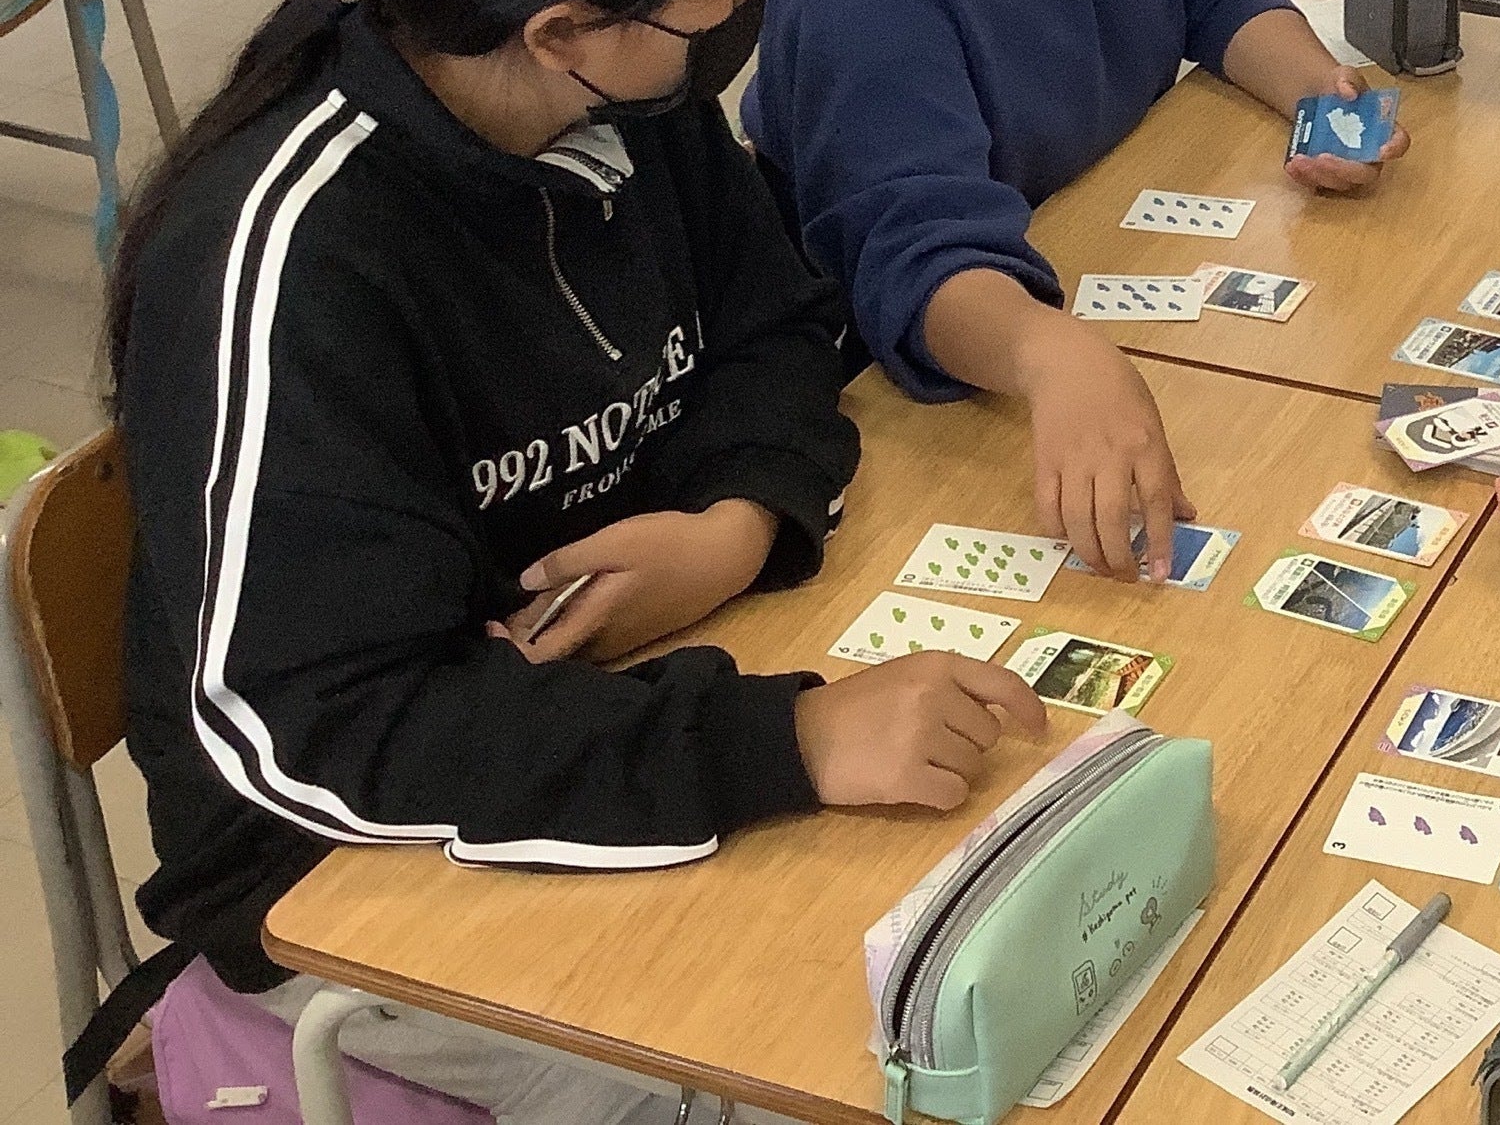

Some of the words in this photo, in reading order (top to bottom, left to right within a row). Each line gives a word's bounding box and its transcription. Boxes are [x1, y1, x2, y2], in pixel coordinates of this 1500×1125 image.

[472, 439, 553, 510] 992
[1052, 541, 1067, 550] 10
[900, 573, 916, 583] 10
[1332, 840, 1346, 851] 3
